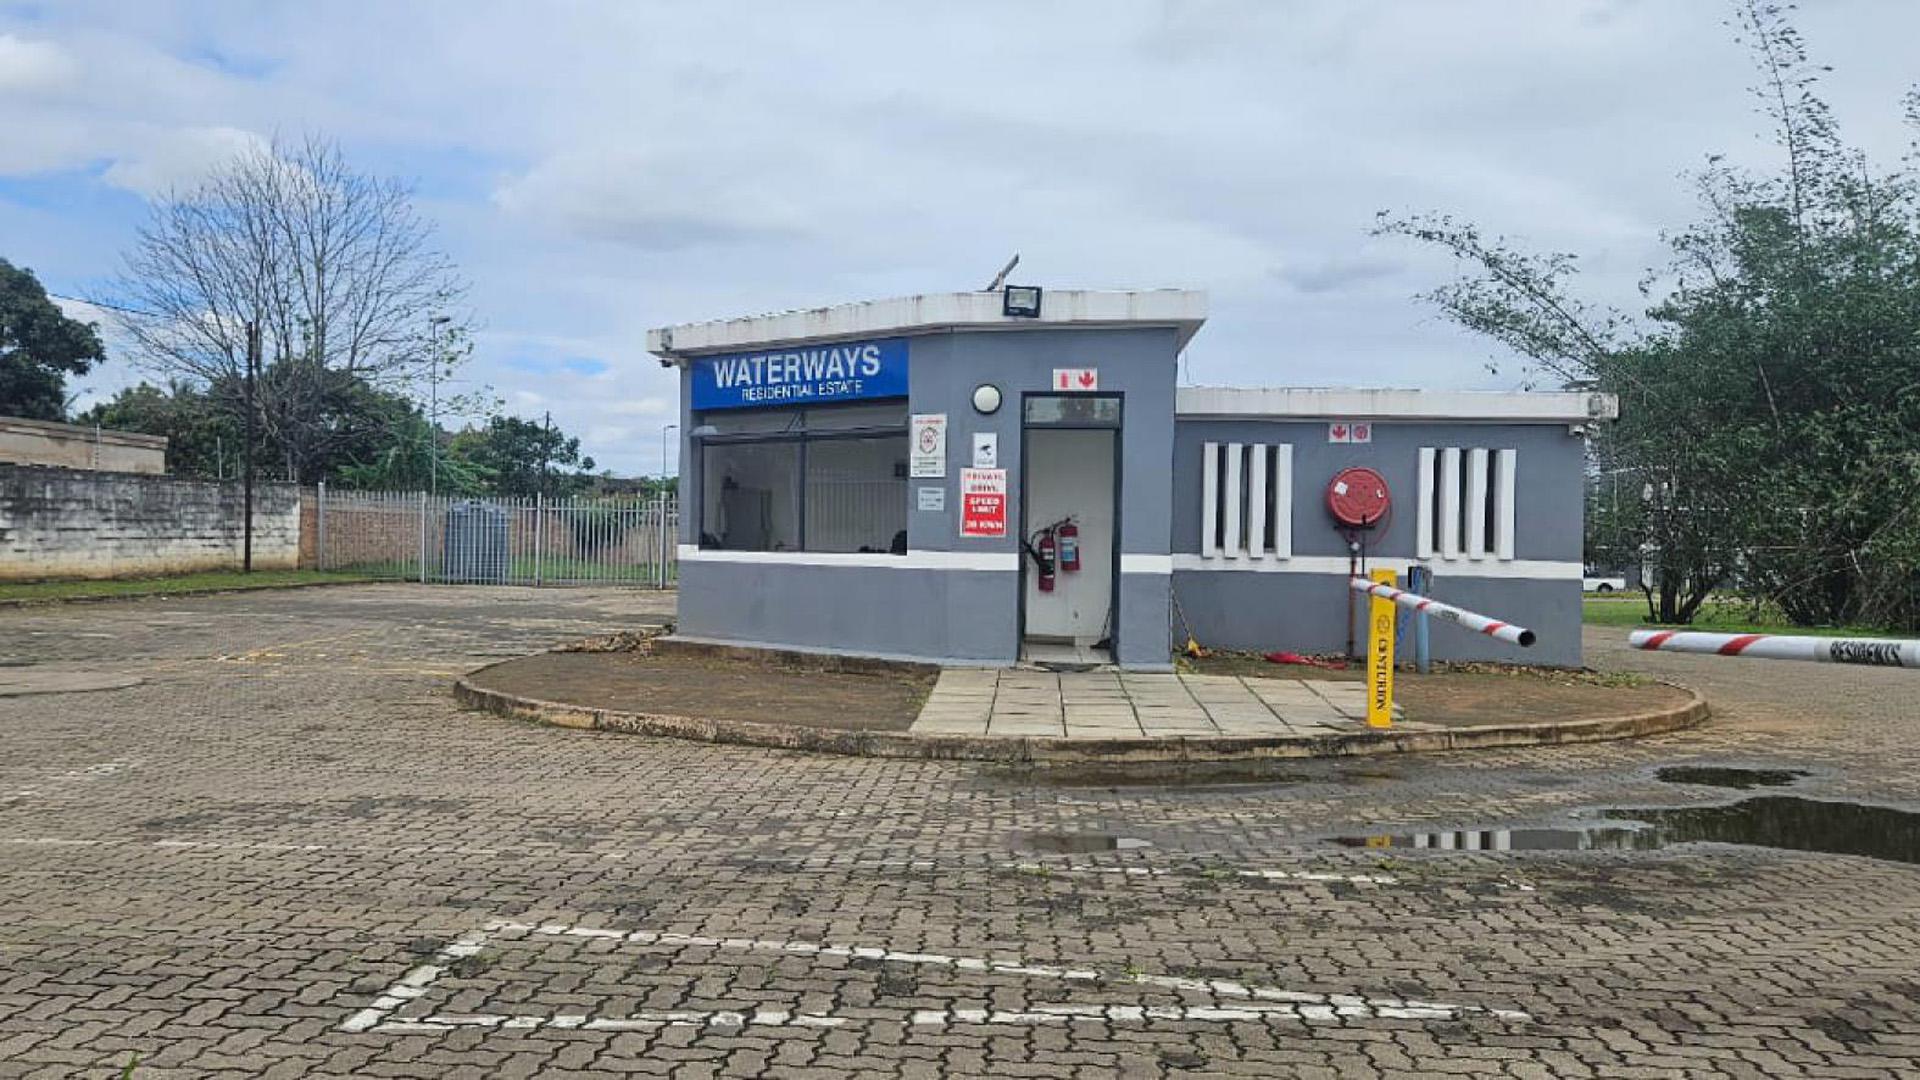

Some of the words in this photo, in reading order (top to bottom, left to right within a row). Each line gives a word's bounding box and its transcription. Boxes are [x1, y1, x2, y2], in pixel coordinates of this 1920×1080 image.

[713, 344, 881, 389] WATERWAYS
[742, 382, 816, 401] RESIDENTIAL
[818, 379, 864, 396] ESTATE
[969, 497, 1000, 506] SPEED
[972, 505, 998, 514] LIMIT
[1830, 640, 1902, 666] RESIDENTS
[1376, 639, 1389, 711] CENTURION
